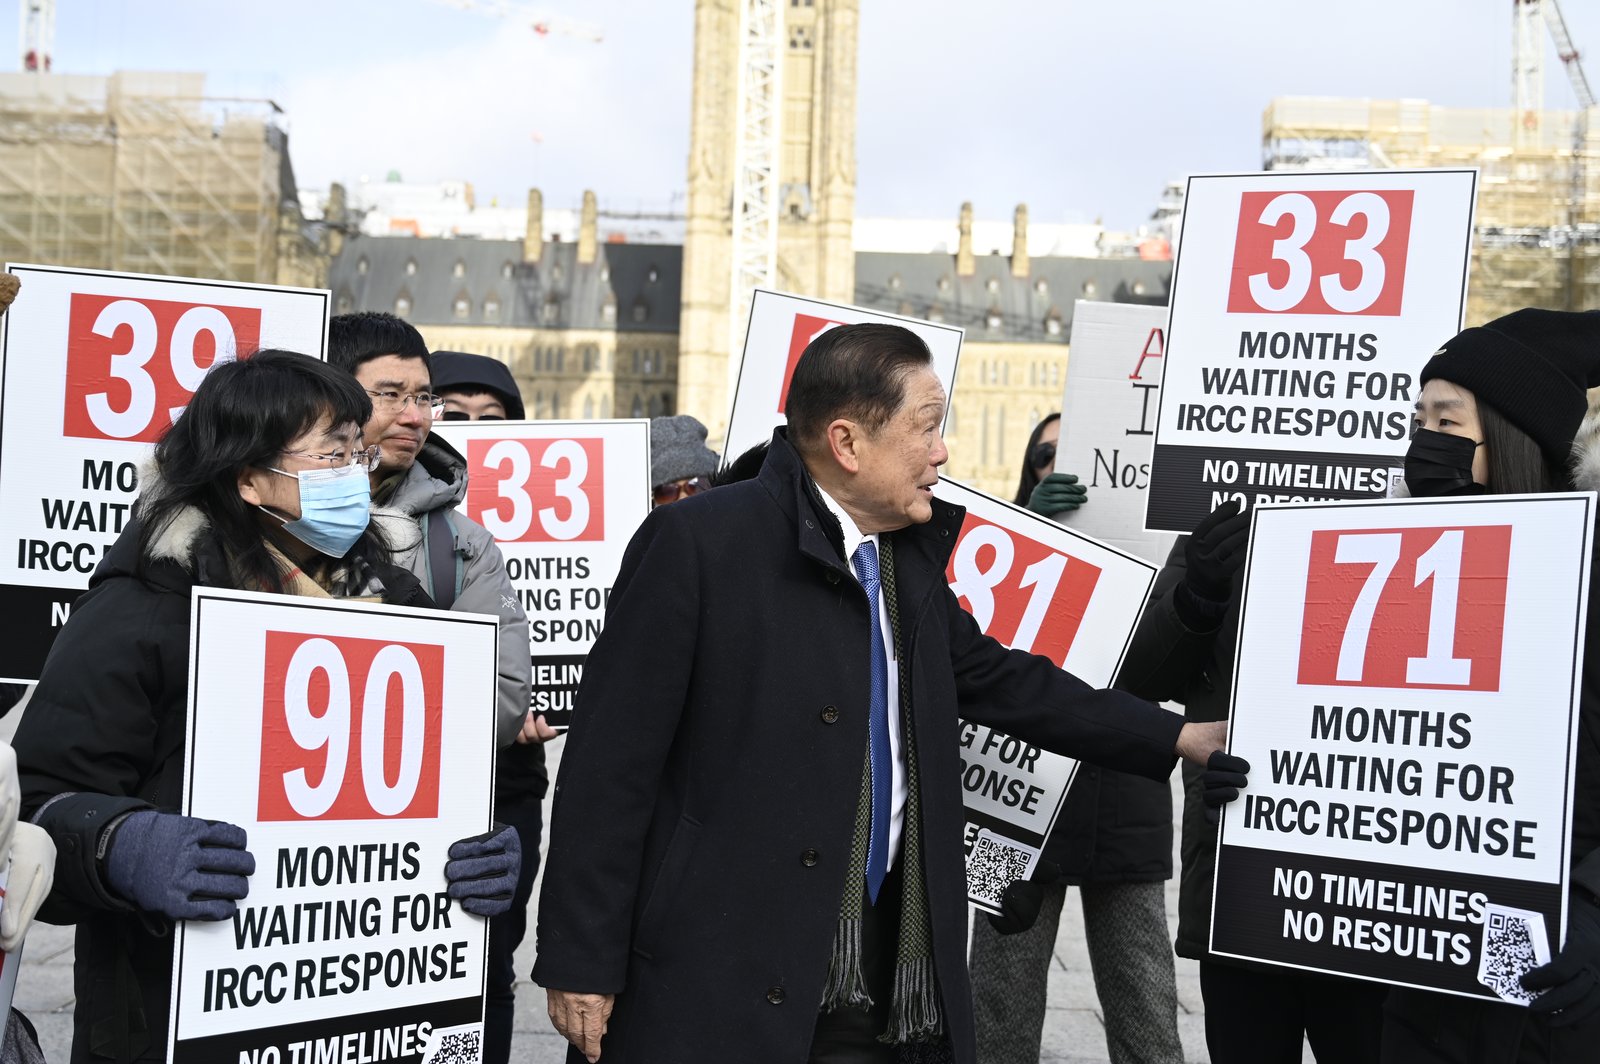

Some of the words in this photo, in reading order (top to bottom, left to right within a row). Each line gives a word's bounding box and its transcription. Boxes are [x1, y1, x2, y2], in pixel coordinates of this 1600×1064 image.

[1248, 192, 1391, 313] 33
[85, 299, 237, 438] 39
[1238, 331, 1378, 361] MONTHS
[1201, 368, 1336, 399] WAITING
[1346, 372, 1411, 401] FOR
[1176, 404, 1246, 434] IRCC
[481, 439, 590, 541] 33
[1202, 459, 1239, 484] NO
[1245, 461, 1388, 492] TIMELINES
[41, 498, 133, 534] WAIT
[18, 538, 95, 573] IRCC
[948, 524, 1068, 650] 81
[1334, 530, 1472, 686] 71
[528, 619, 600, 642] SPON
[531, 664, 583, 685] ELIN
[282, 638, 425, 818] 90
[980, 729, 1041, 774] FOR
[1311, 705, 1472, 749] MONTHS
[1270, 749, 1422, 797] WAITING
[1436, 763, 1514, 805] FOR
[1244, 795, 1320, 837] IRCC
[1326, 804, 1538, 860] RESPONSE
[276, 841, 420, 889] MONTHS
[1273, 868, 1313, 900] NO
[1321, 872, 1489, 922] TIMELINES
[232, 898, 381, 950] WAITING
[392, 892, 452, 935] FOR
[1283, 911, 1323, 943] NO
[1332, 917, 1472, 965] RESULTS
[203, 962, 287, 1012] IRCC
[295, 941, 468, 999] RESPONSE
[288, 1021, 433, 1064] TIMELINES
